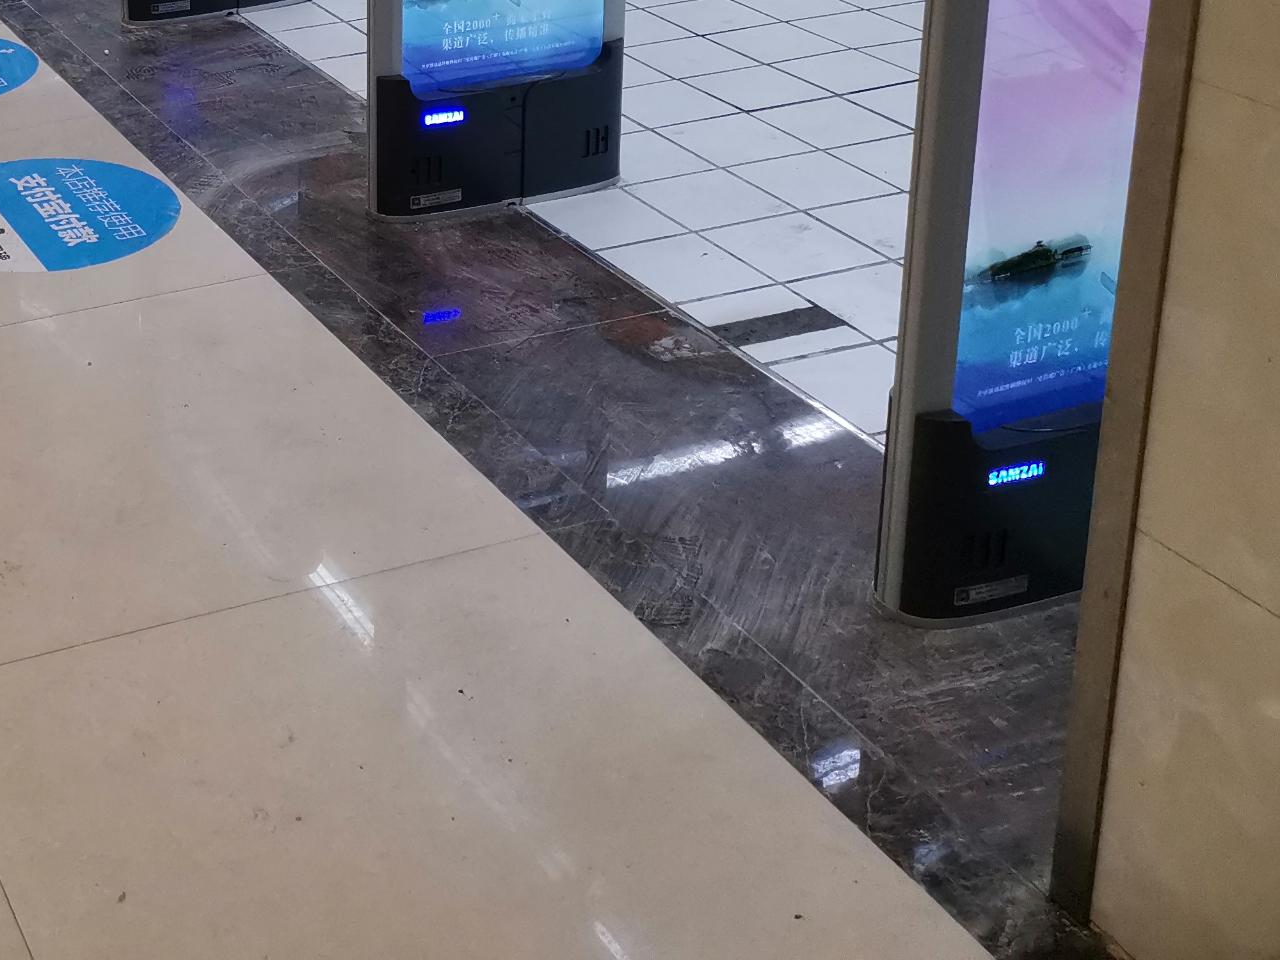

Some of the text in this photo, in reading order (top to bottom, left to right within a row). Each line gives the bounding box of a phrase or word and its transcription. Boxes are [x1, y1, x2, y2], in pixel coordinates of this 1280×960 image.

[8, 173, 101, 247] 支付宝付款
[55, 164, 146, 240] 本店推荐使用
[988, 461, 1045, 486] SAMZAI
